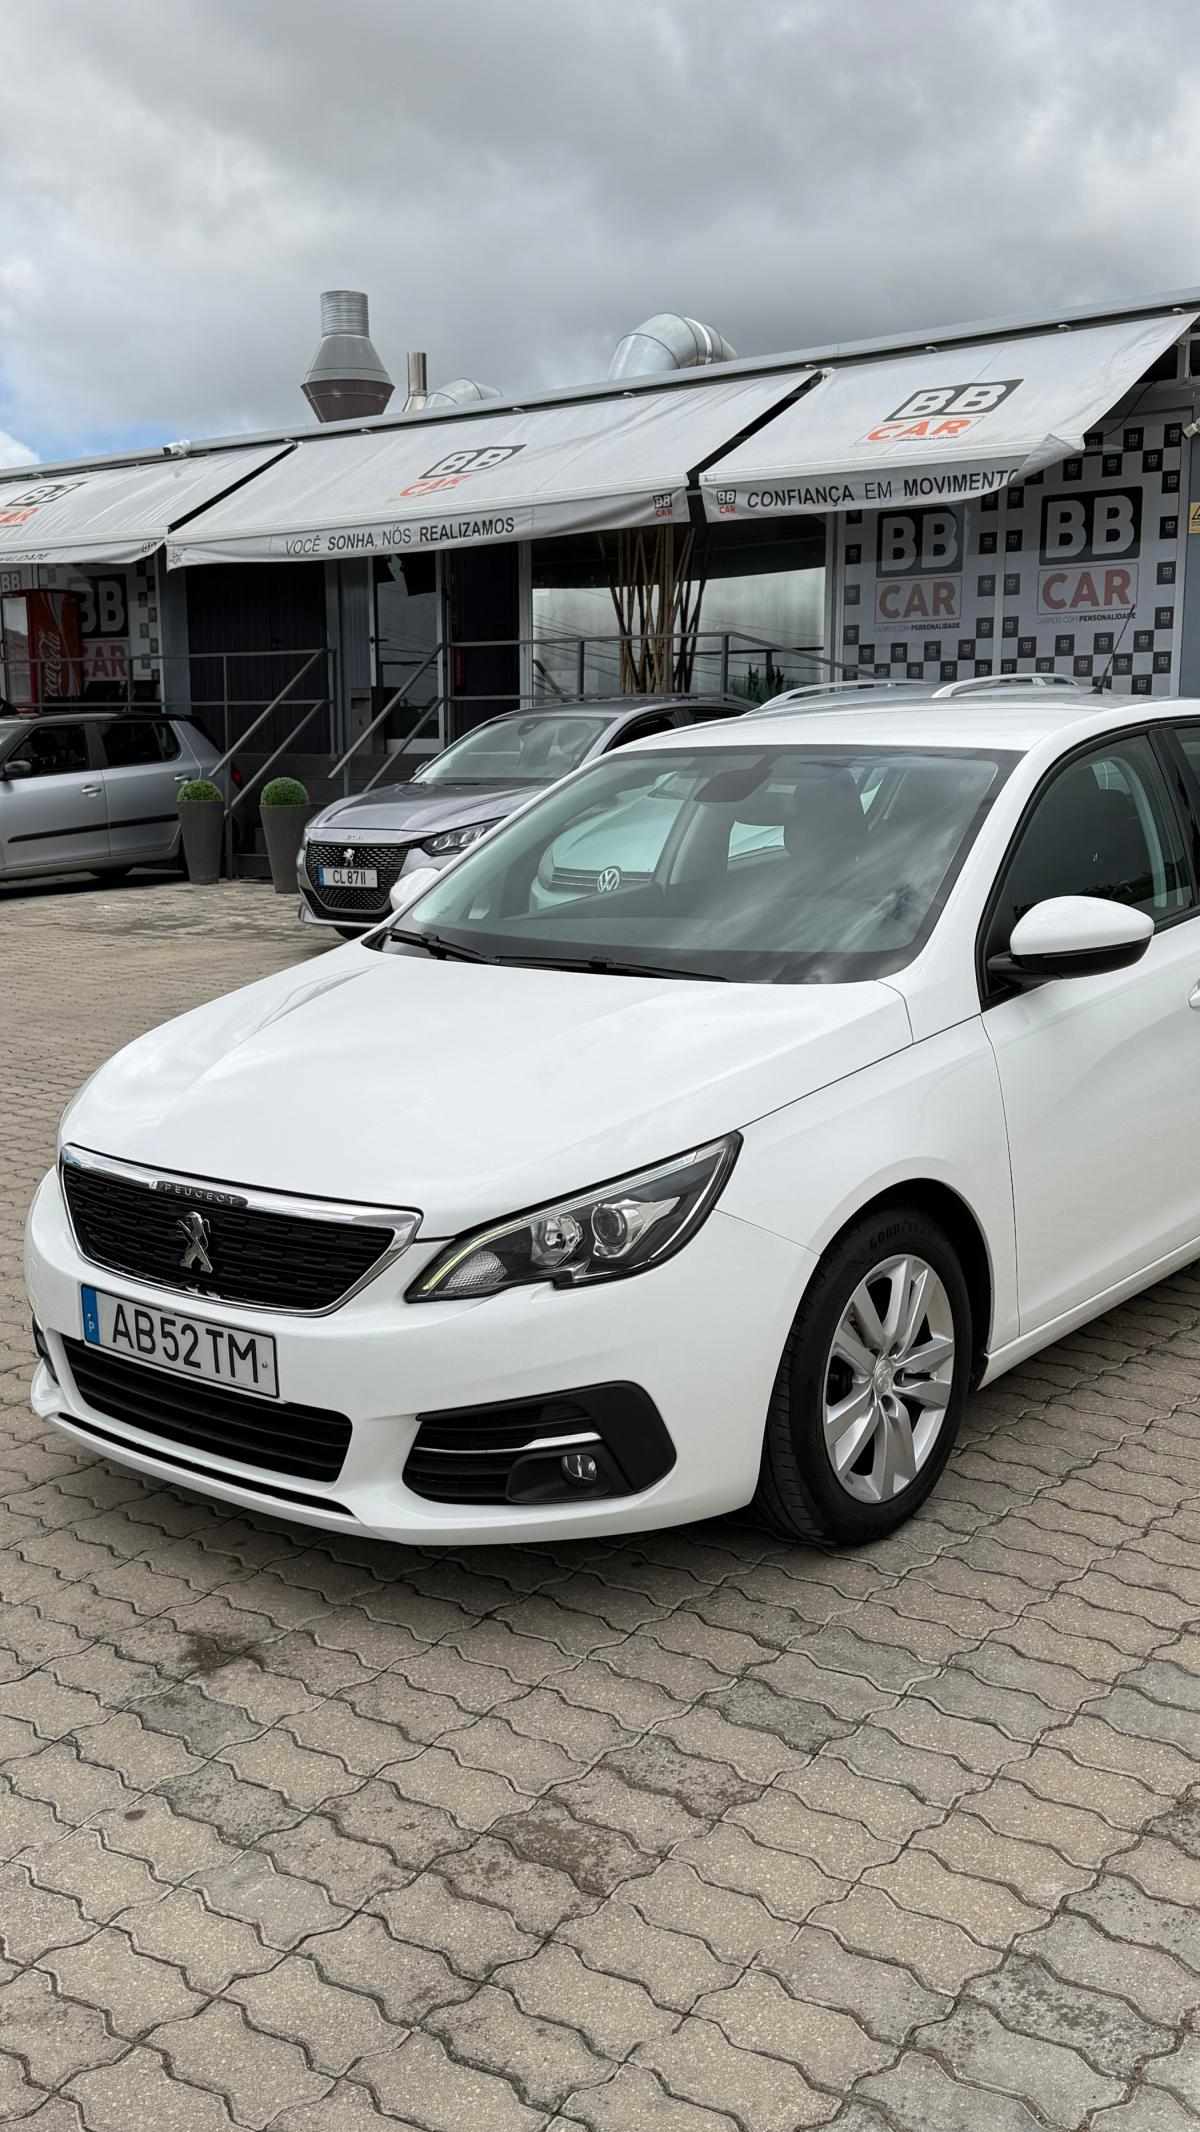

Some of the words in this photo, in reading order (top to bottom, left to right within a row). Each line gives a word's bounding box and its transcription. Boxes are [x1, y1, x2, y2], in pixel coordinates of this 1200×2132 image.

[893, 384, 1007, 419] BB
[867, 419, 971, 441] CAR
[422, 448, 513, 477] BB
[747, 485, 854, 507] CONFIANÇA
[864, 482, 892, 500] EM
[285, 535, 321, 555] VOCÊ
[327, 535, 378, 552] SONHA,
[382, 526, 412, 545] NÓS
[419, 517, 515, 543] REALIZAMOS
[882, 512, 958, 572] BB
[1046, 495, 1135, 559] BB
[879, 581, 957, 618] CAR
[1042, 568, 1132, 610] CAR
[911, 622, 961, 632] PERSONALIDADE
[1079, 612, 1136, 623] PERSONALIDADE
[164, 1183, 236, 1205] PEUGEOT
[112, 1304, 259, 1383] AB52TM
